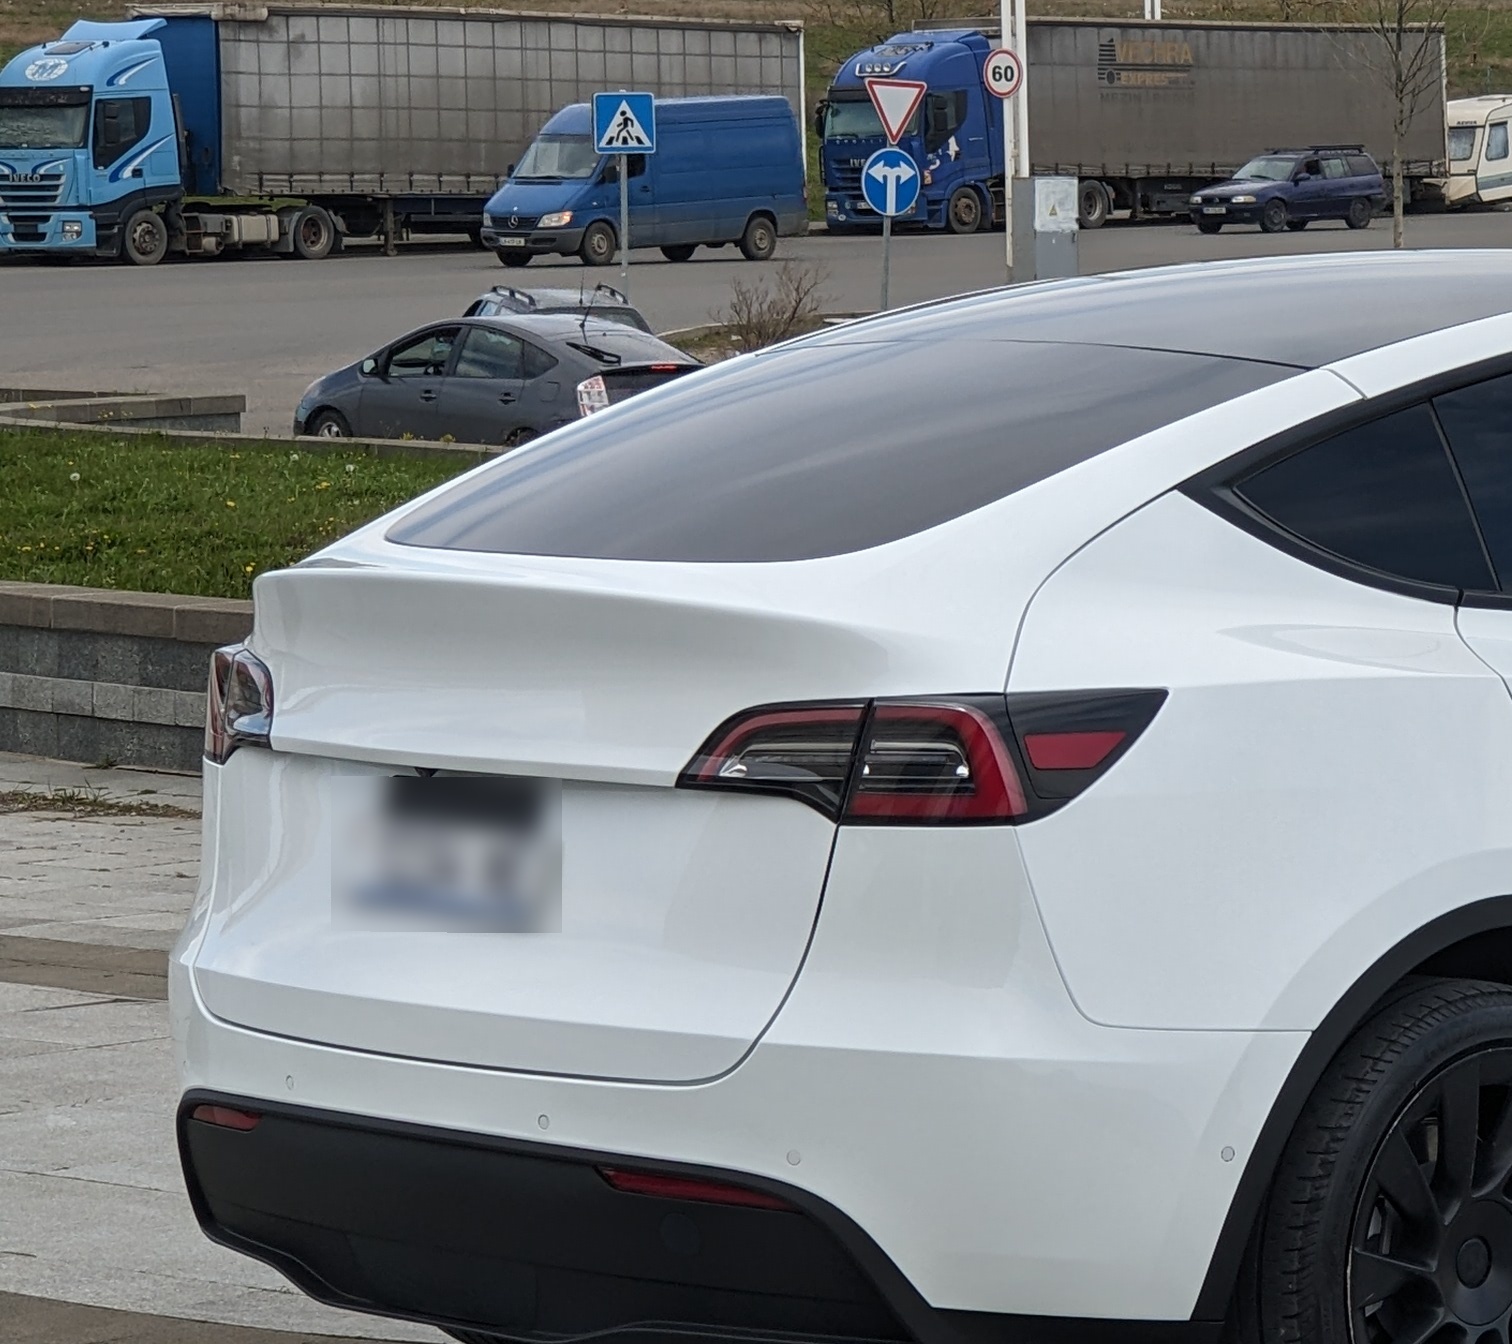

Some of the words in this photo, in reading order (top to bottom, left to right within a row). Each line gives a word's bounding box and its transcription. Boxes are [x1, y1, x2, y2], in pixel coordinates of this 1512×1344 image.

[1116, 40, 1193, 64] VECHRA
[992, 65, 1014, 82] 60
[850, 158, 866, 168] IVE
[9, 173, 41, 182] IVECO
